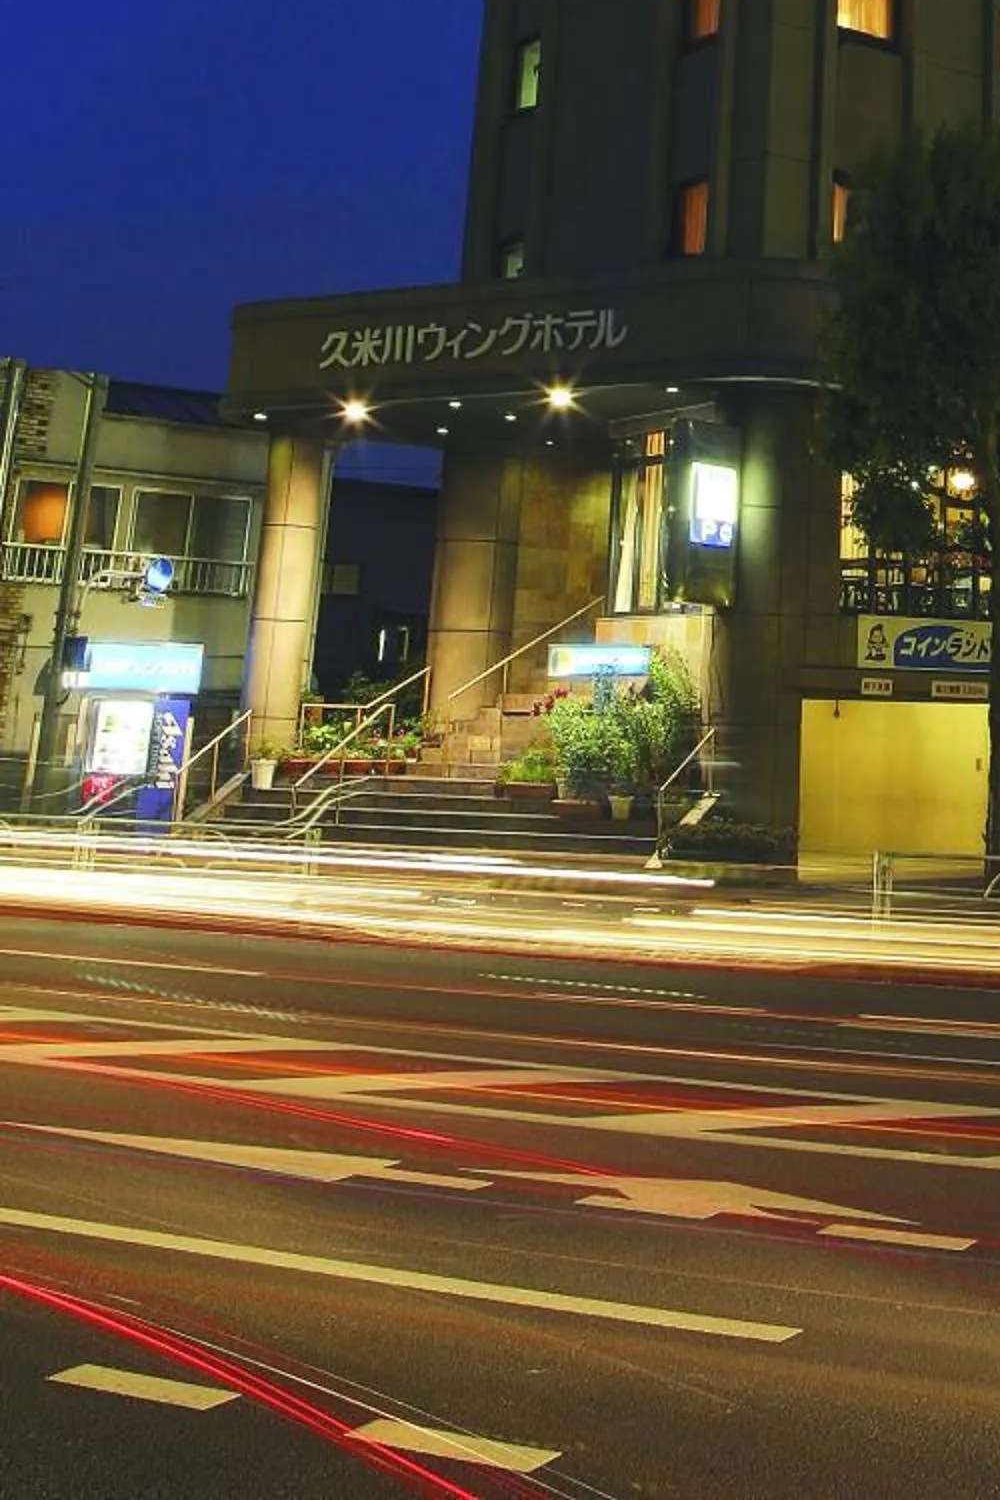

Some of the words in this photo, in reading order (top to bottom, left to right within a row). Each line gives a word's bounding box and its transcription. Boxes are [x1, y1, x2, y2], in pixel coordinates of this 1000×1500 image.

[319, 309, 628, 369] 久米川ウィングホテル
